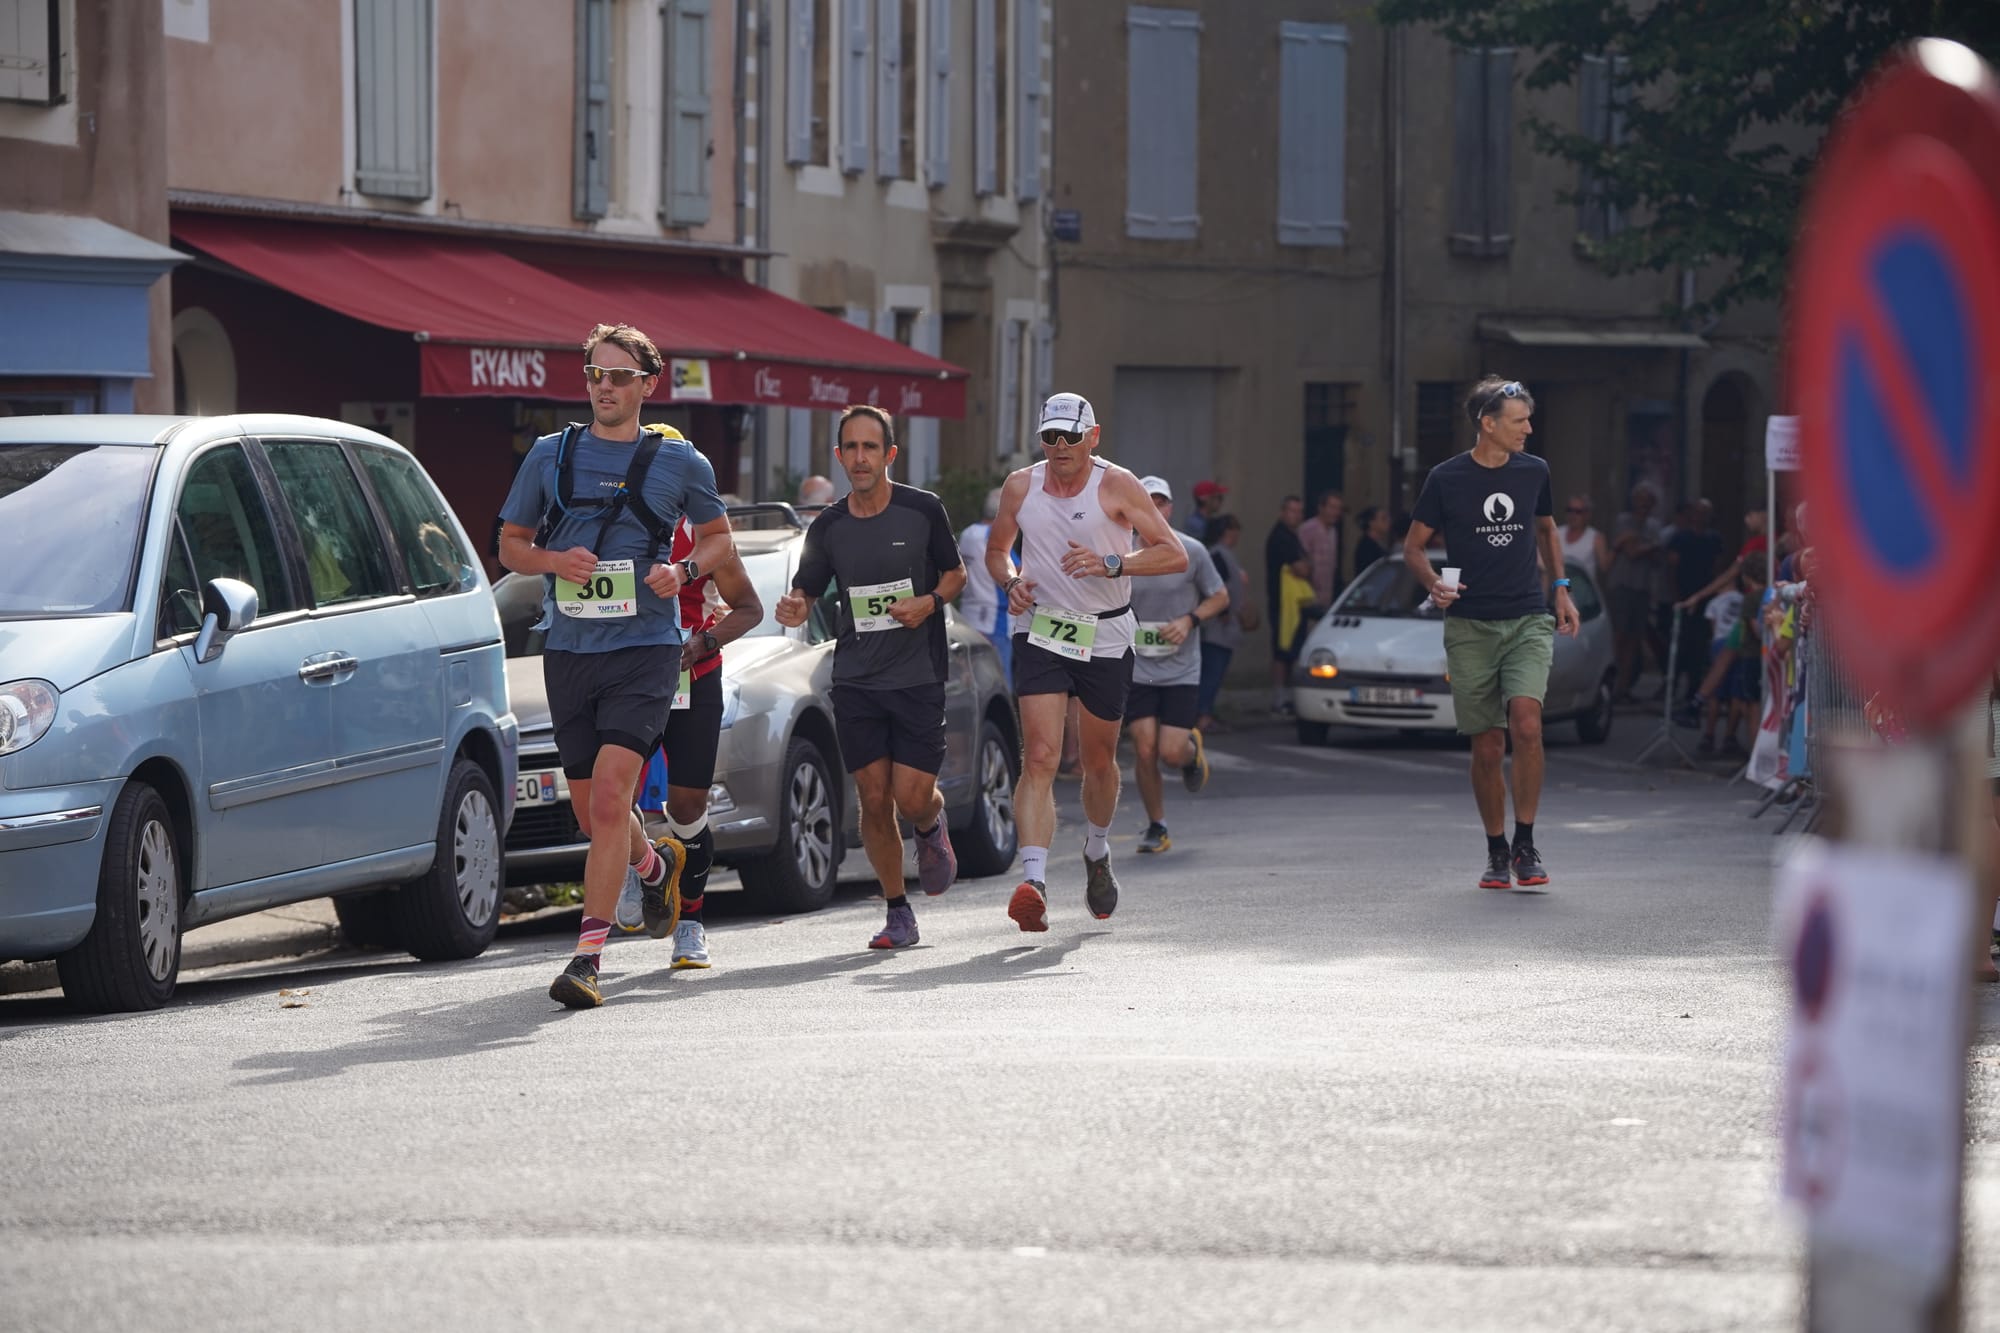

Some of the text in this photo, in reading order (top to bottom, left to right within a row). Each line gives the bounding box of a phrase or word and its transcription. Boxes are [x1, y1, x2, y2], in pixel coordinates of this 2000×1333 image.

[471, 350, 546, 387] RYAN'S
[1475, 523, 1523, 534] PARIS 2024
[577, 576, 614, 600] 30
[1050, 619, 1078, 643] 72
